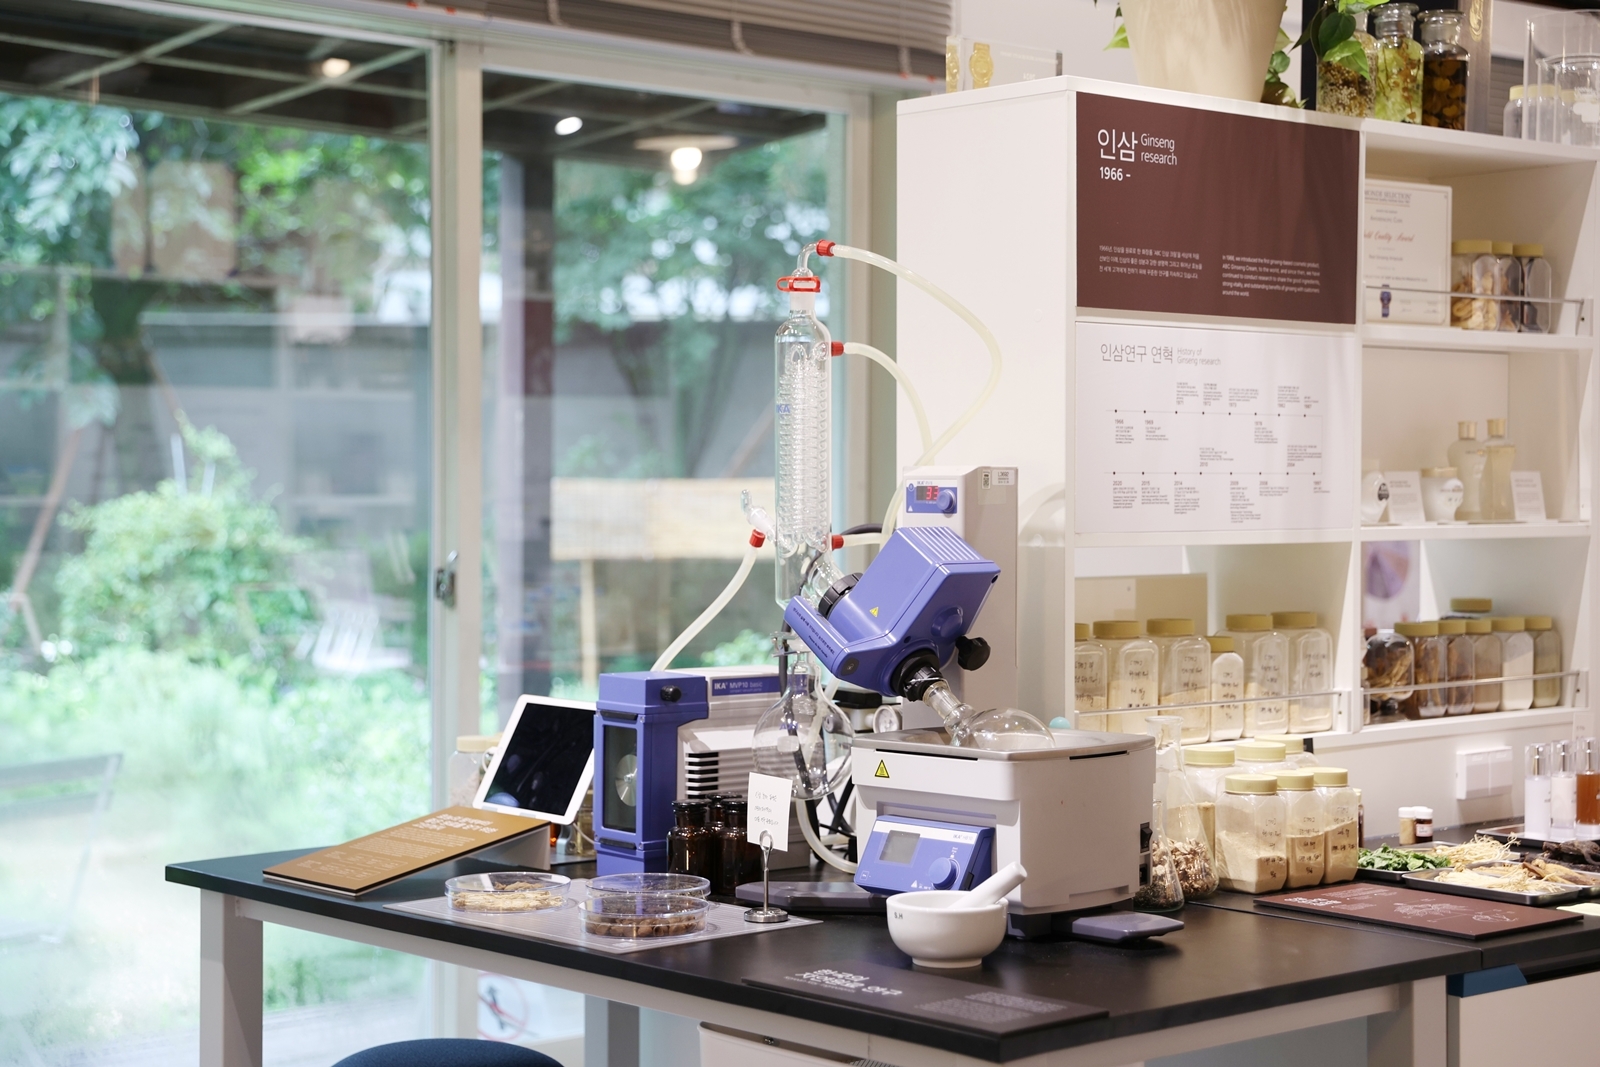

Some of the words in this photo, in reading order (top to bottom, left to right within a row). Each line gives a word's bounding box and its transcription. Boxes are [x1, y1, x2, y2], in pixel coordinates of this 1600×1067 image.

[1098, 129, 1138, 162] 인삼
[1141, 133, 1175, 152] Ginseng
[1141, 152, 1177, 165] research
[1100, 166, 1123, 181] 1966
[1101, 344, 1147, 362] 인삼연구
[1151, 346, 1173, 364] 연혁
[1177, 348, 1195, 357] History
[1197, 348, 1202, 356] of
[1177, 356, 1198, 366] Ginseng
